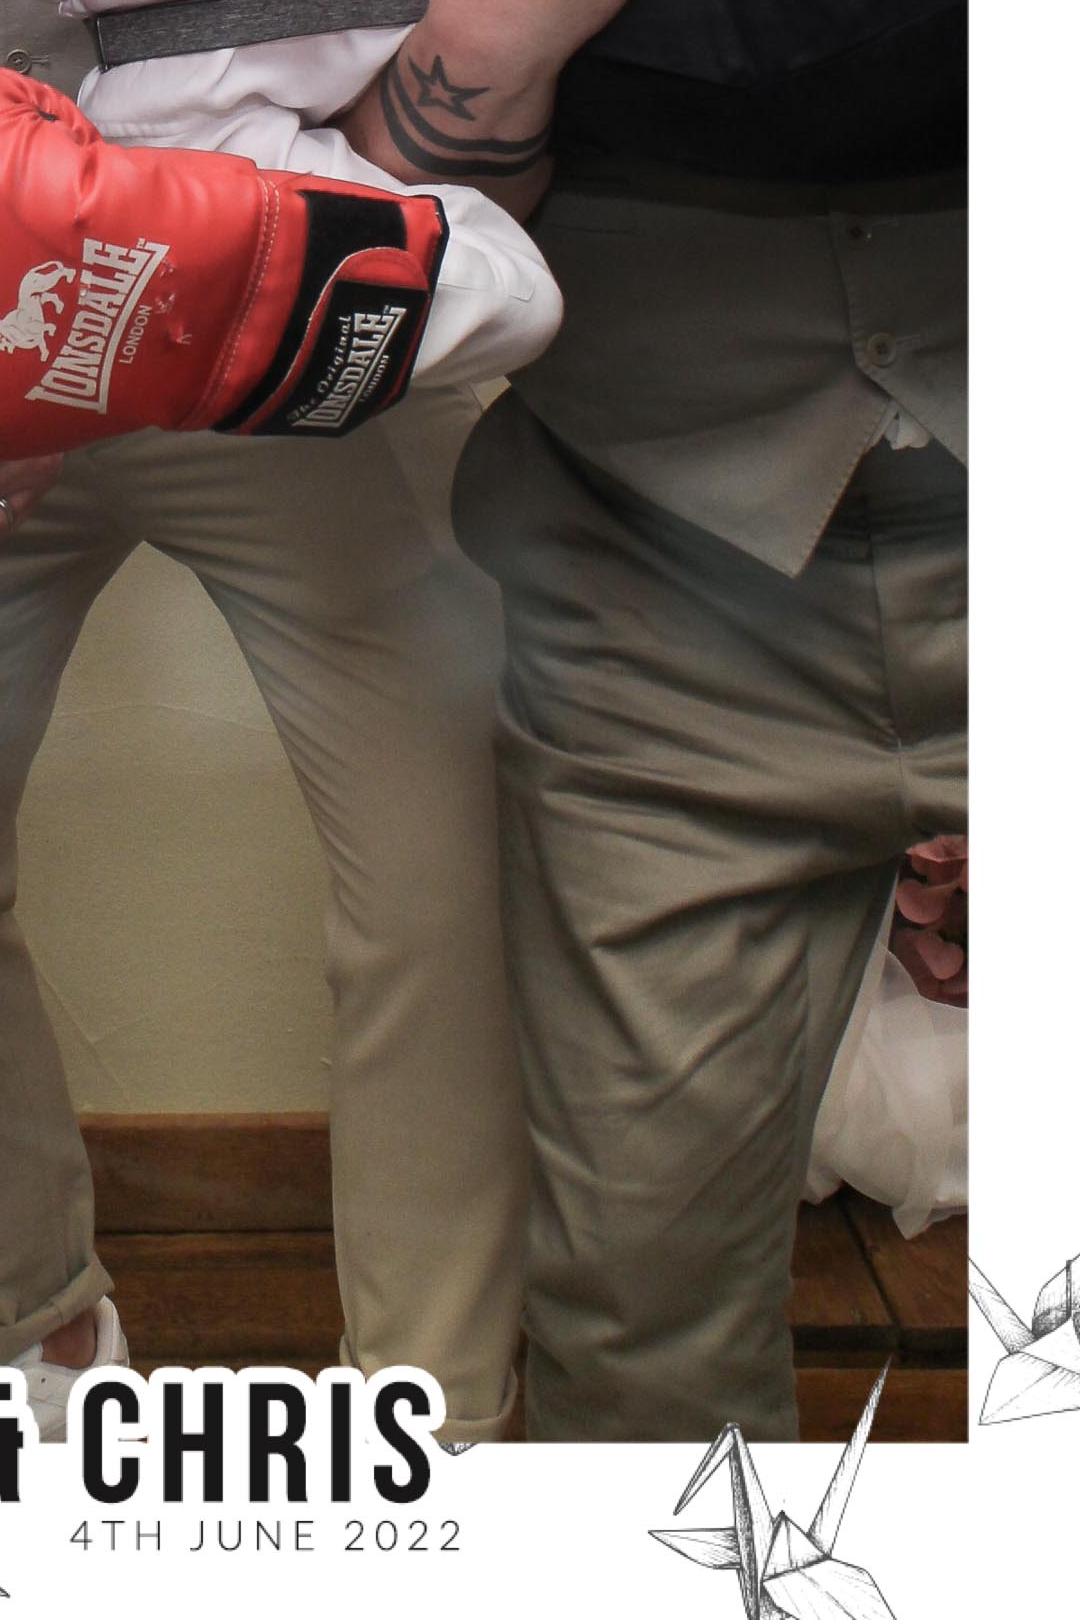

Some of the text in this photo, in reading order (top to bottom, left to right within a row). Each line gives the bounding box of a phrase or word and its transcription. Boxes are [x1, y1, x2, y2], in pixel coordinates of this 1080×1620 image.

[24, 237, 171, 415] LONSDALE
[118, 304, 153, 365] LONDON
[291, 306, 408, 429] LONSDALE
